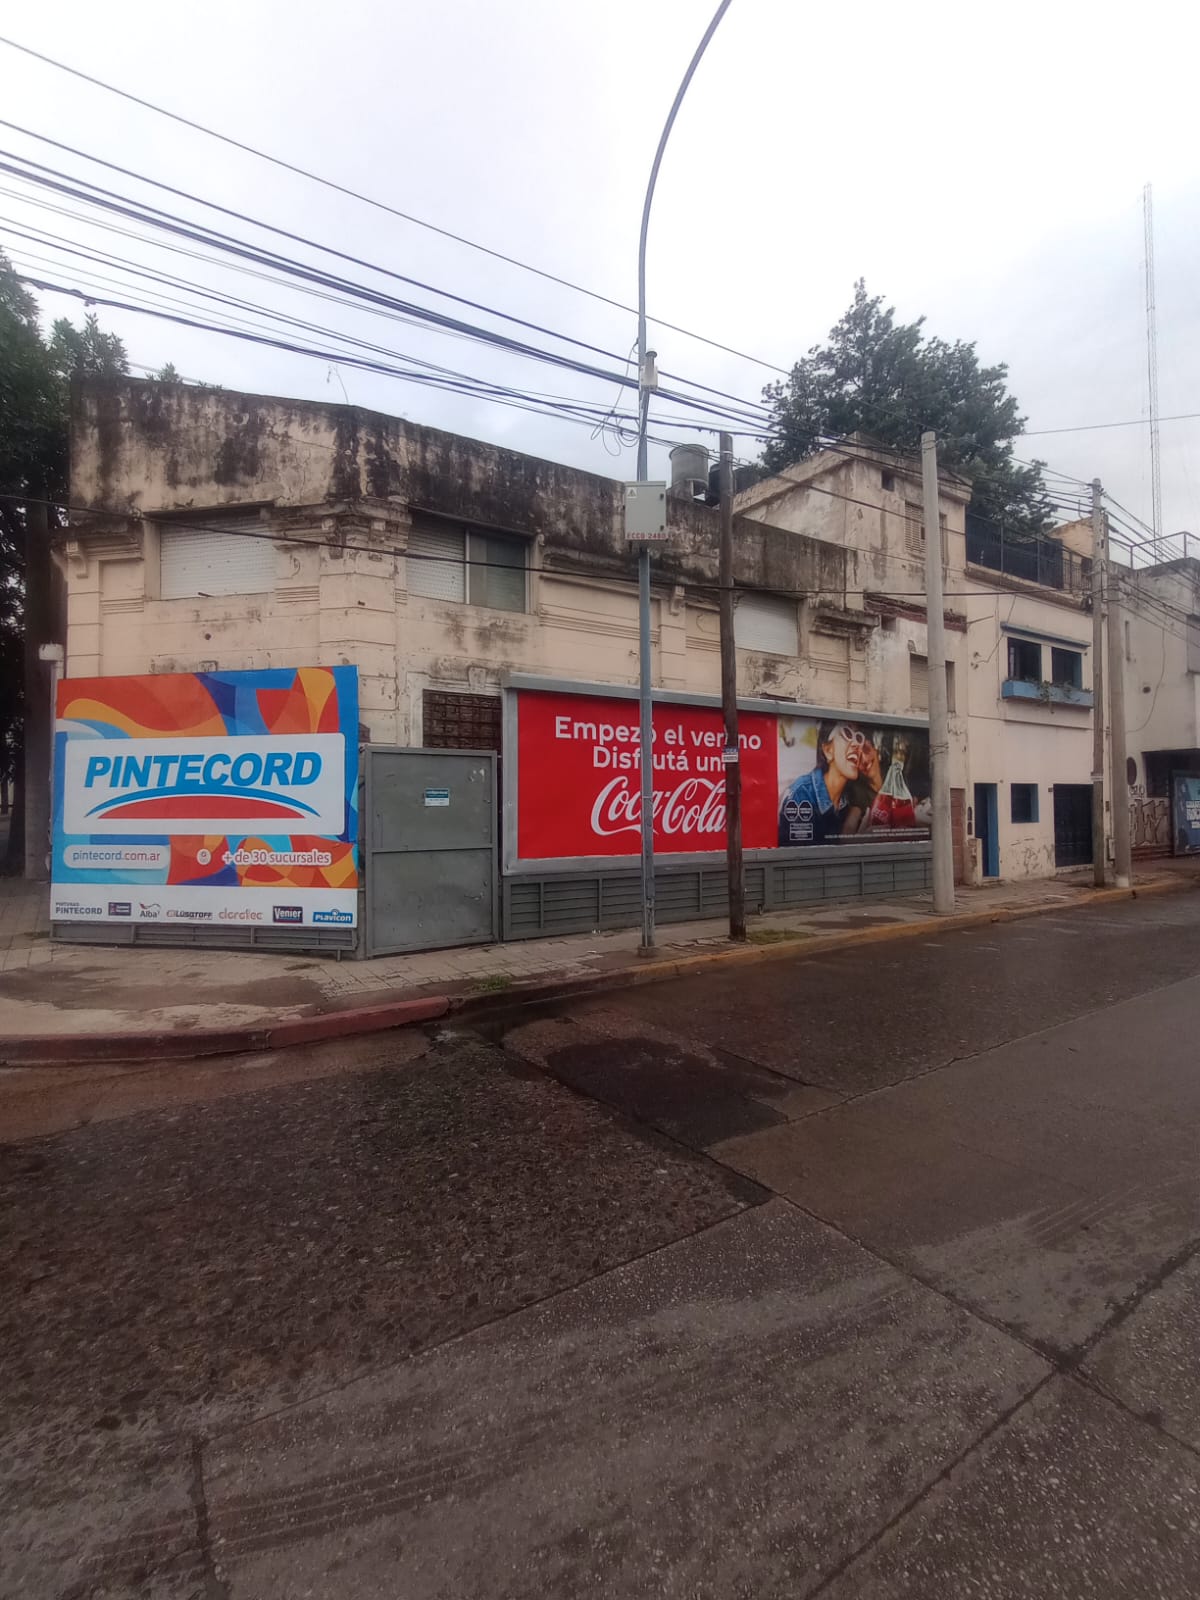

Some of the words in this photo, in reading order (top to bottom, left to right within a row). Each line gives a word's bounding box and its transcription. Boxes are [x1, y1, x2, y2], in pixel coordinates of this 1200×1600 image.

[664, 725, 685, 746] el
[691, 730, 762, 750] verno
[593, 746, 689, 771] Disfutá
[84, 751, 323, 788] PINTECORD
[72, 850, 161, 862] pintecord.com.ar
[235, 851, 250, 863] de
[253, 852, 267, 863] 30
[270, 851, 330, 864] sucursales
[56, 907, 103, 915] PINTECORD
[140, 910, 158, 918] Alba
